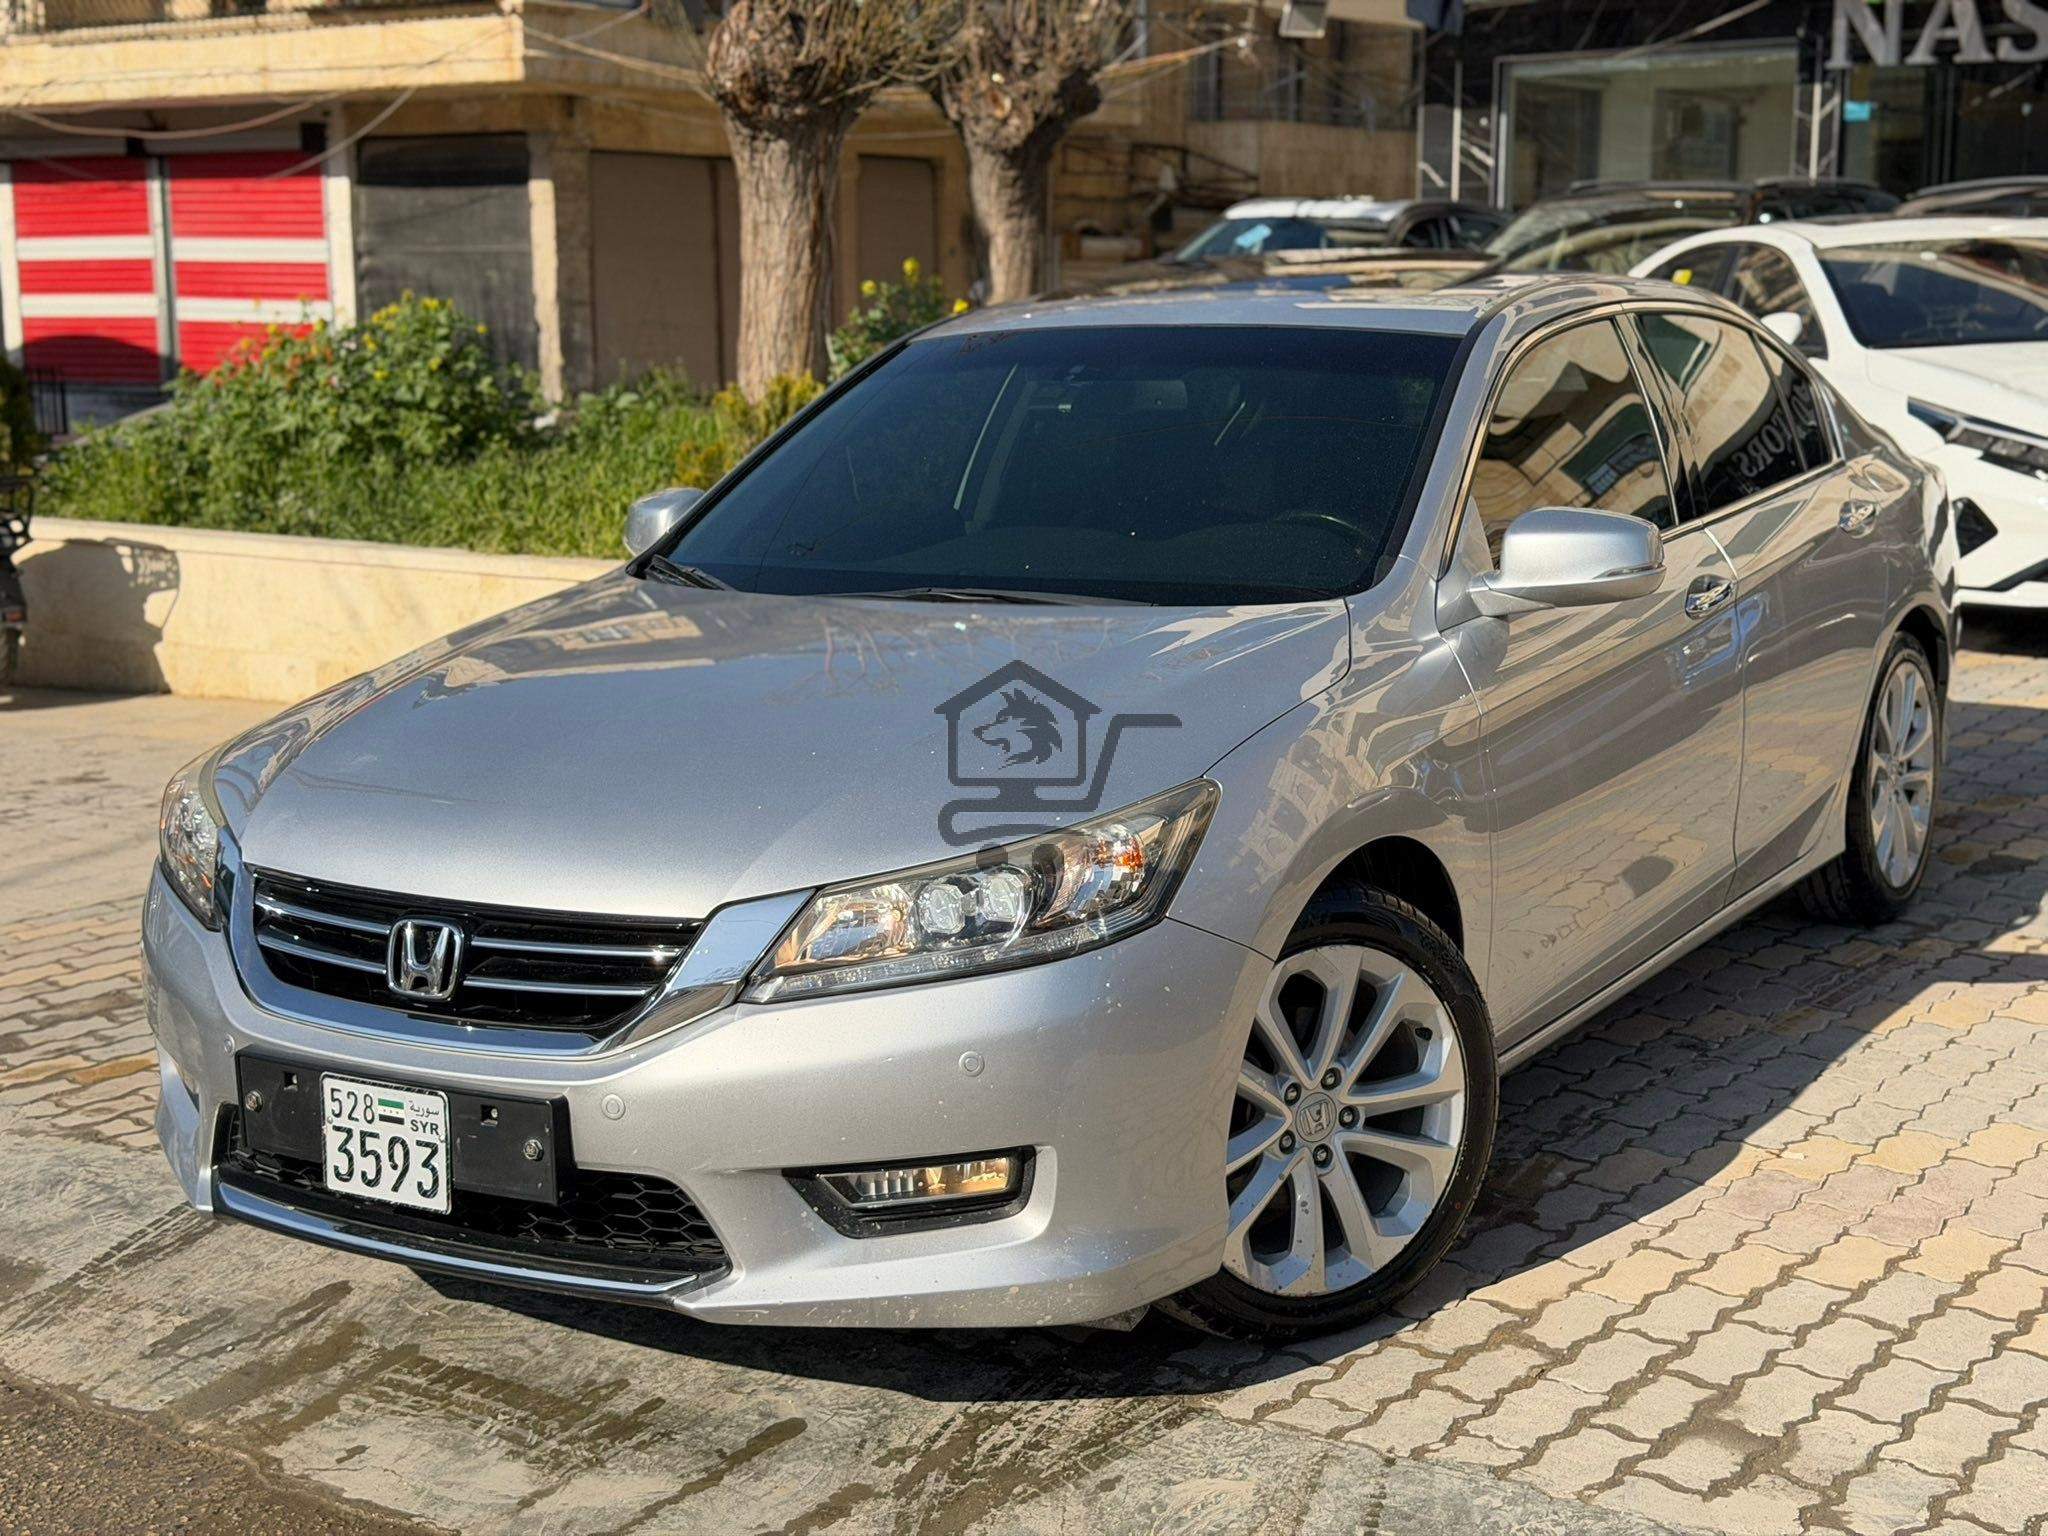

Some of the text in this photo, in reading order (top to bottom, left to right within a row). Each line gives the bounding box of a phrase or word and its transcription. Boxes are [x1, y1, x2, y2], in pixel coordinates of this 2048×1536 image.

[330, 1087, 375, 1125] 528
[408, 1100, 440, 1117] سورية
[410, 1118, 440, 1136] SYR
[331, 1124, 440, 1199] 3593
